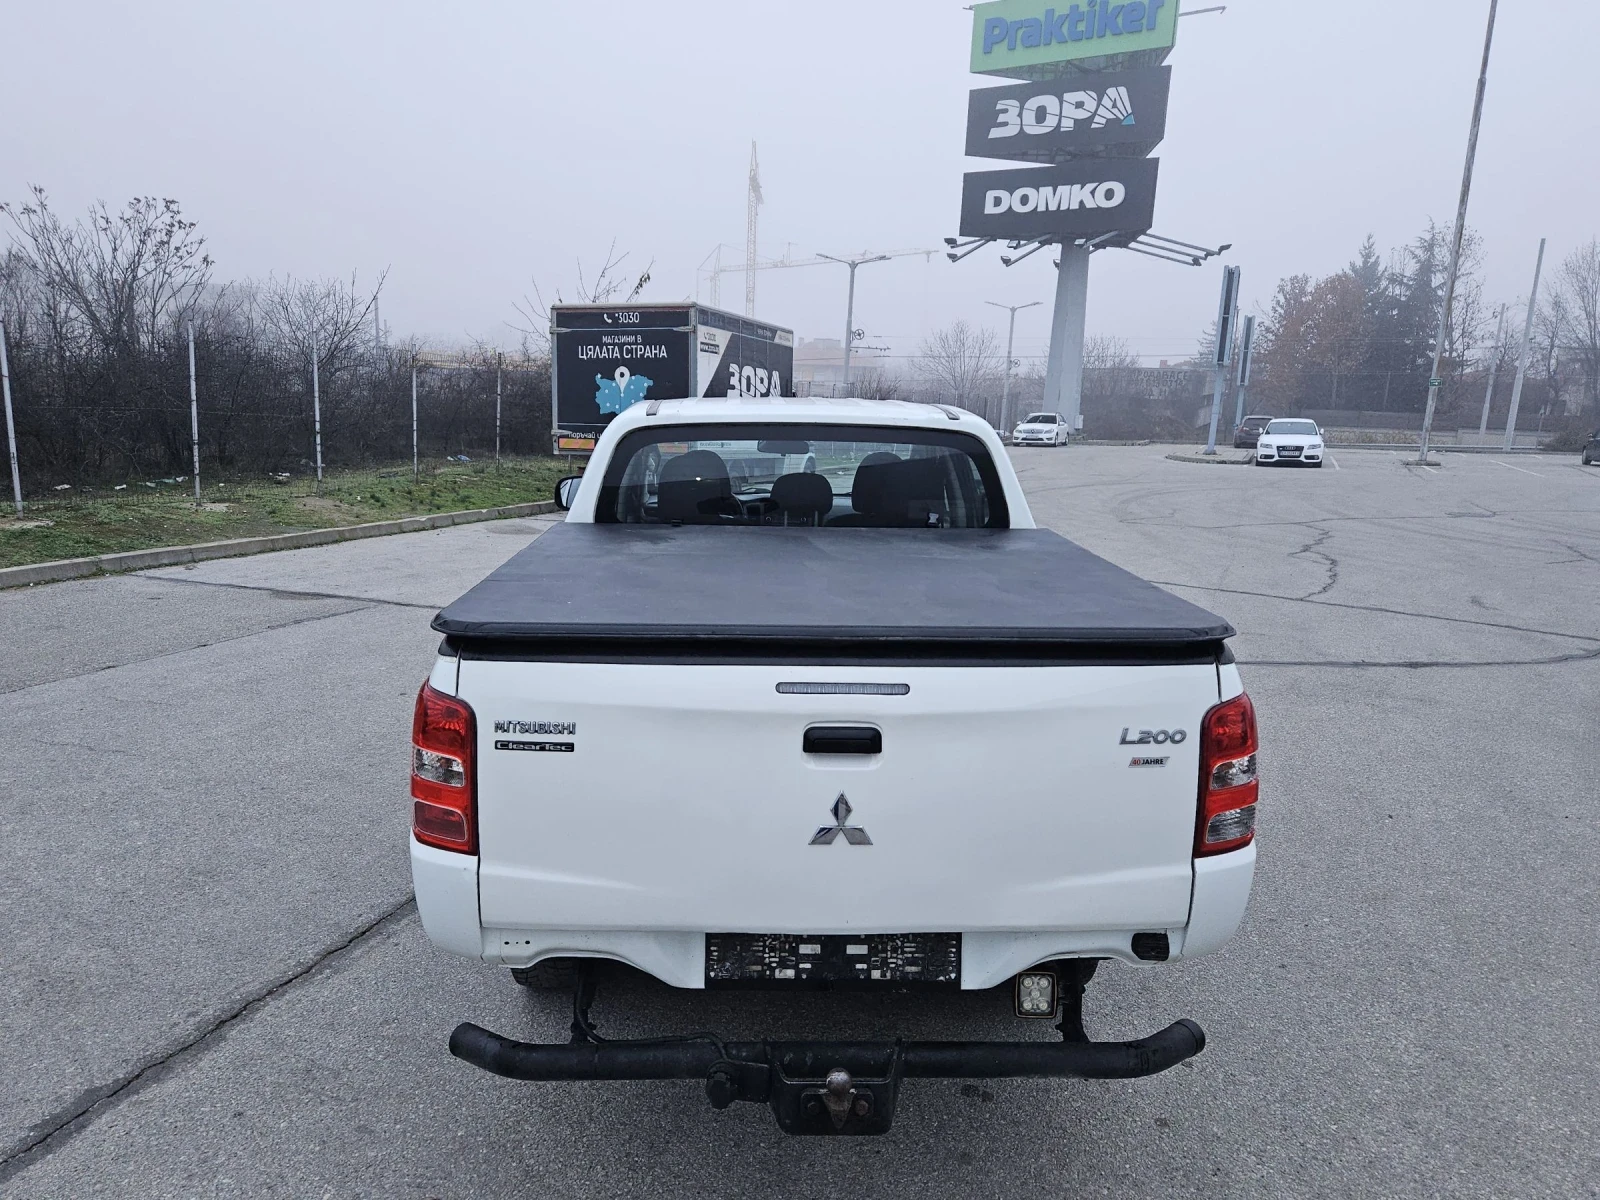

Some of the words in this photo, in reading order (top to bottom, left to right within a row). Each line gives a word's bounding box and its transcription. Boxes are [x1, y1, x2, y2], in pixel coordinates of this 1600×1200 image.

[983, 0, 1164, 54] Praktiker
[988, 86, 1135, 139] ЗОРА
[984, 181, 1126, 214] DOMKO
[602, 335, 635, 343] МАГАЗИНИ
[636, 334, 642, 343] В
[578, 345, 621, 360] ЦЯЛАТА
[623, 345, 668, 358] СТРАНА
[494, 720, 576, 735] MITSUBISHI
[1119, 727, 1187, 745] L200
[496, 741, 573, 751] ClearTec
